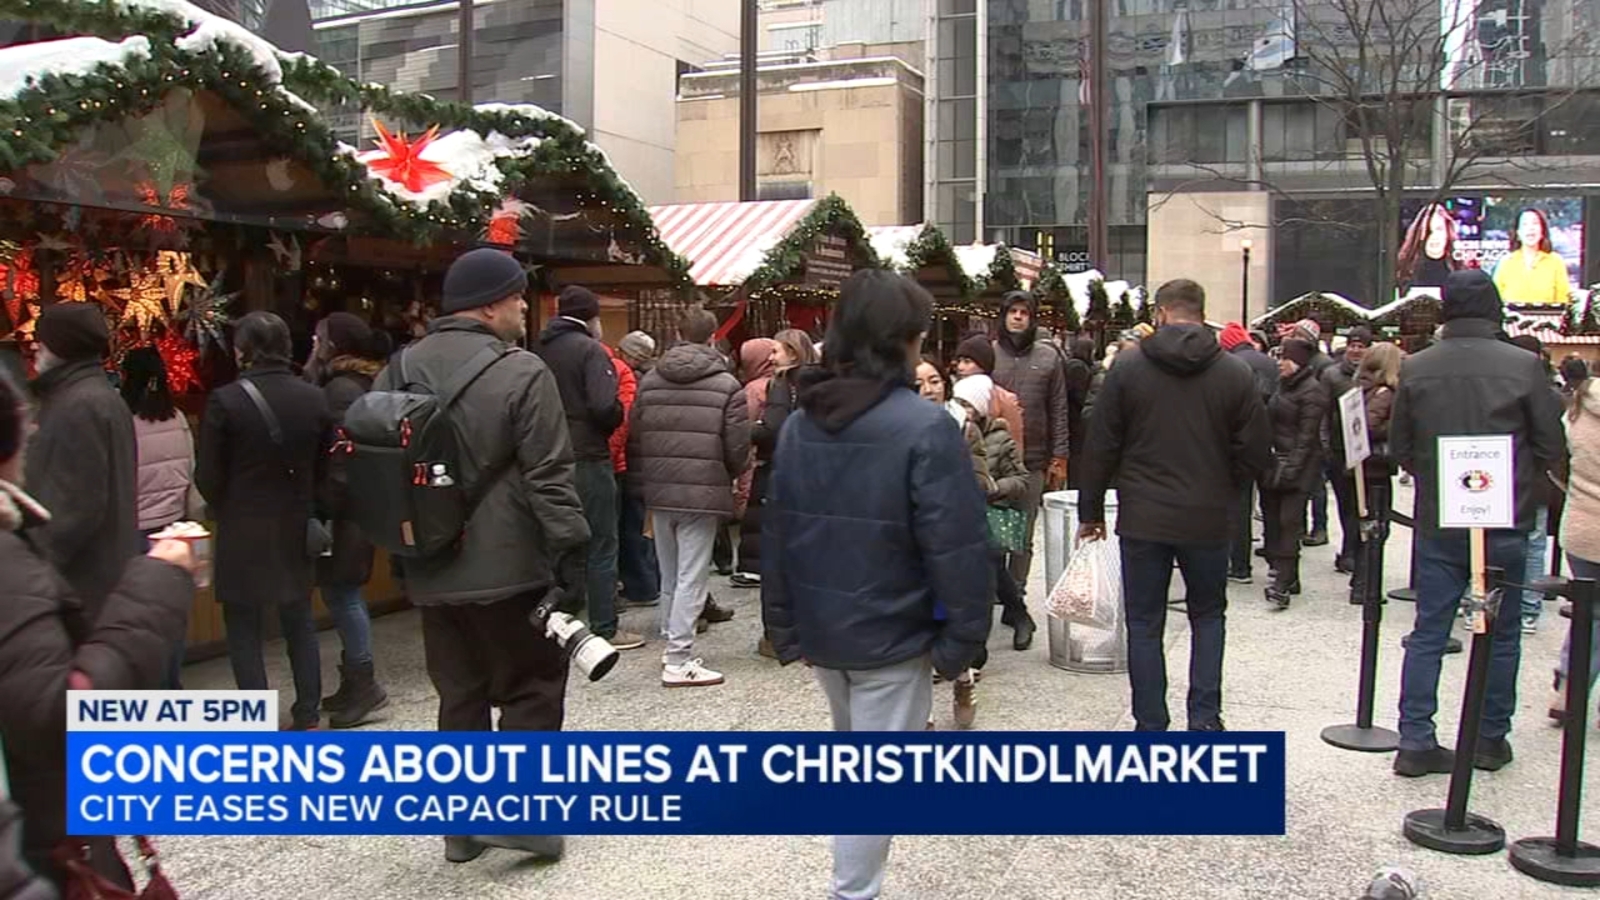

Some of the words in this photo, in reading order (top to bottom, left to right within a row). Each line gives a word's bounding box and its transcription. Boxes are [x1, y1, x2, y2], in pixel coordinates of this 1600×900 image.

[1453, 249, 1510, 260] CHICAGO
[1450, 450, 1500, 459] Entrance
[1460, 504, 1491, 516] Enjoy!
